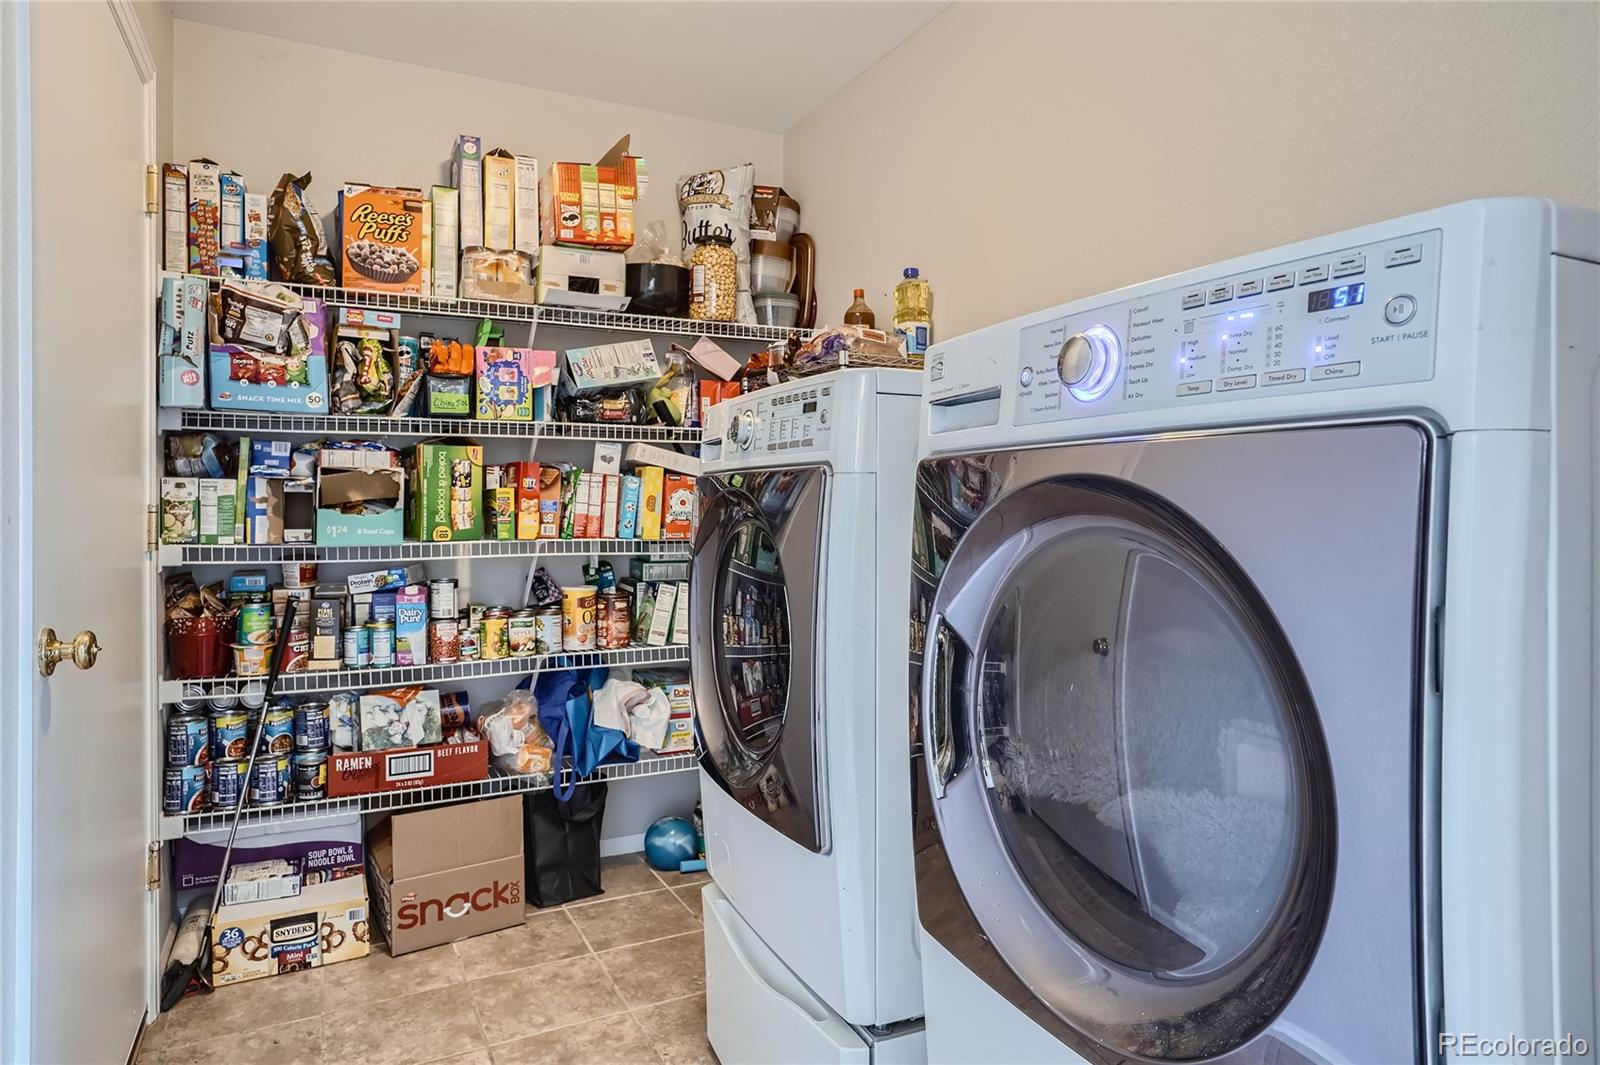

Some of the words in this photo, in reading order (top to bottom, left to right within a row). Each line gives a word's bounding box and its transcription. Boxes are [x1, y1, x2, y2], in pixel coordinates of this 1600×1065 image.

[351, 202, 415, 226] Reese's
[358, 221, 411, 243] Puffs
[1334, 284, 1364, 307] 51
[1133, 306, 1150, 314] Casual
[1324, 315, 1350, 324] Connect
[1131, 334, 1152, 343] Delicates
[1370, 335, 1394, 345] START
[1402, 331, 1429, 340] PAUSE
[1130, 349, 1144, 357] Small
[1129, 363, 1146, 371] Express
[1146, 361, 1154, 369] Dry
[1268, 374, 1285, 382] Timed
[1285, 372, 1297, 380] Dry
[308, 395, 321, 403] 50
[1135, 391, 1143, 399] Dry
[438, 452, 447, 477] baked
[436, 488, 446, 521] popped
[379, 527, 395, 535] Cups
[439, 528, 448, 538] 18
[350, 578, 374, 587] Protein
[399, 608, 424, 618] Dairy
[673, 689, 689, 697] Dole
[437, 748, 453, 758] BEEF
[455, 745, 479, 756] FLAVOR
[336, 757, 372, 772] RAMEN
[308, 849, 327, 860] SOUP
[328, 847, 347, 857] BOWL
[348, 845, 353, 854] &
[308, 856, 335, 868] NOODLE
[336, 854, 356, 864] BOWL
[397, 880, 511, 930] snack
[510, 880, 520, 905] BOX
[225, 928, 240, 938] 36
[274, 925, 314, 938] SNYDER'S
[283, 944, 303, 952] Calorie
[303, 941, 316, 949] Pack
[286, 952, 304, 961] Mini
